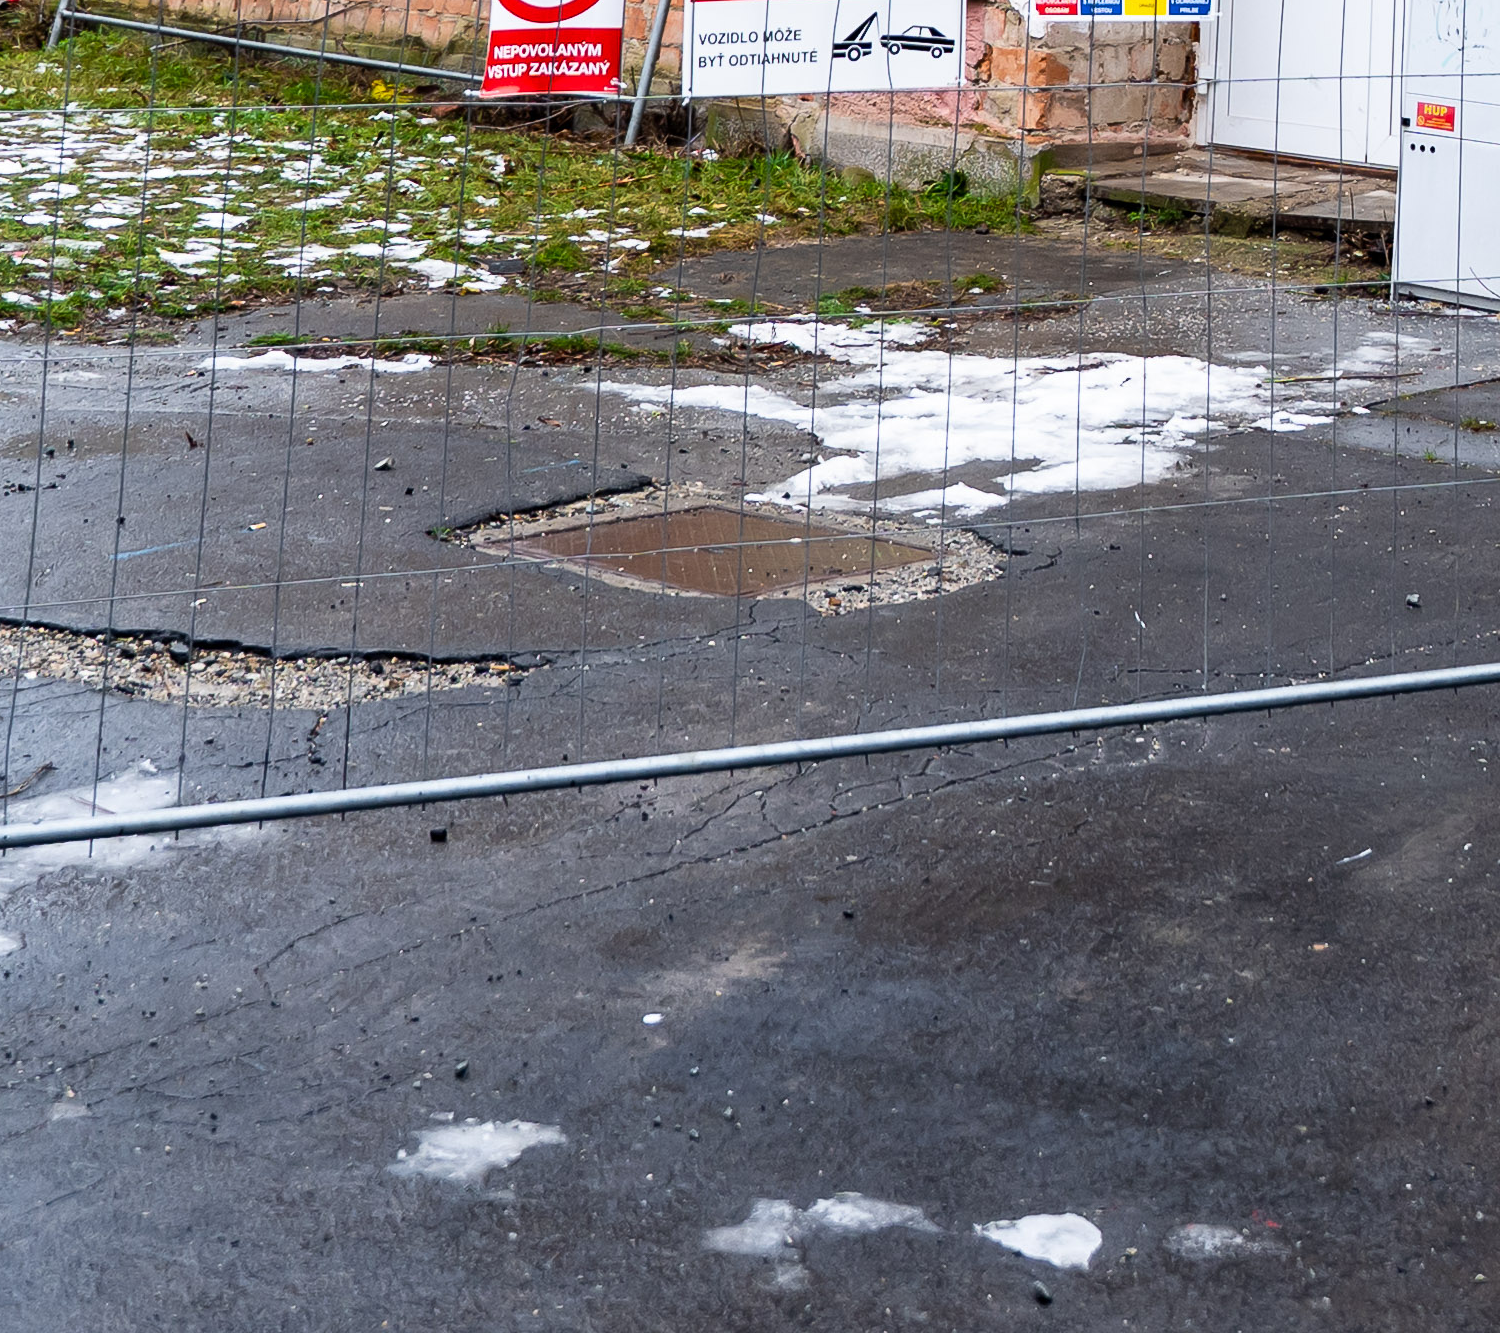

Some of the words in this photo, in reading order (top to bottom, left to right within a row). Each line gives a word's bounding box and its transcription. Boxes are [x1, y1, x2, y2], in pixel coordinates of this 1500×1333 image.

[699, 32, 758, 45] VOZIDLO
[763, 27, 802, 43] MÔŽE
[494, 41, 602, 59] NEPOVOLANÝM
[698, 53, 724, 68] BYŤ
[729, 48, 818, 66] ODTIAHNUTÉ
[487, 63, 527, 79] VSTUP
[529, 58, 611, 77] ZAKÁZANÝ
[1424, 104, 1448, 116] HUP
